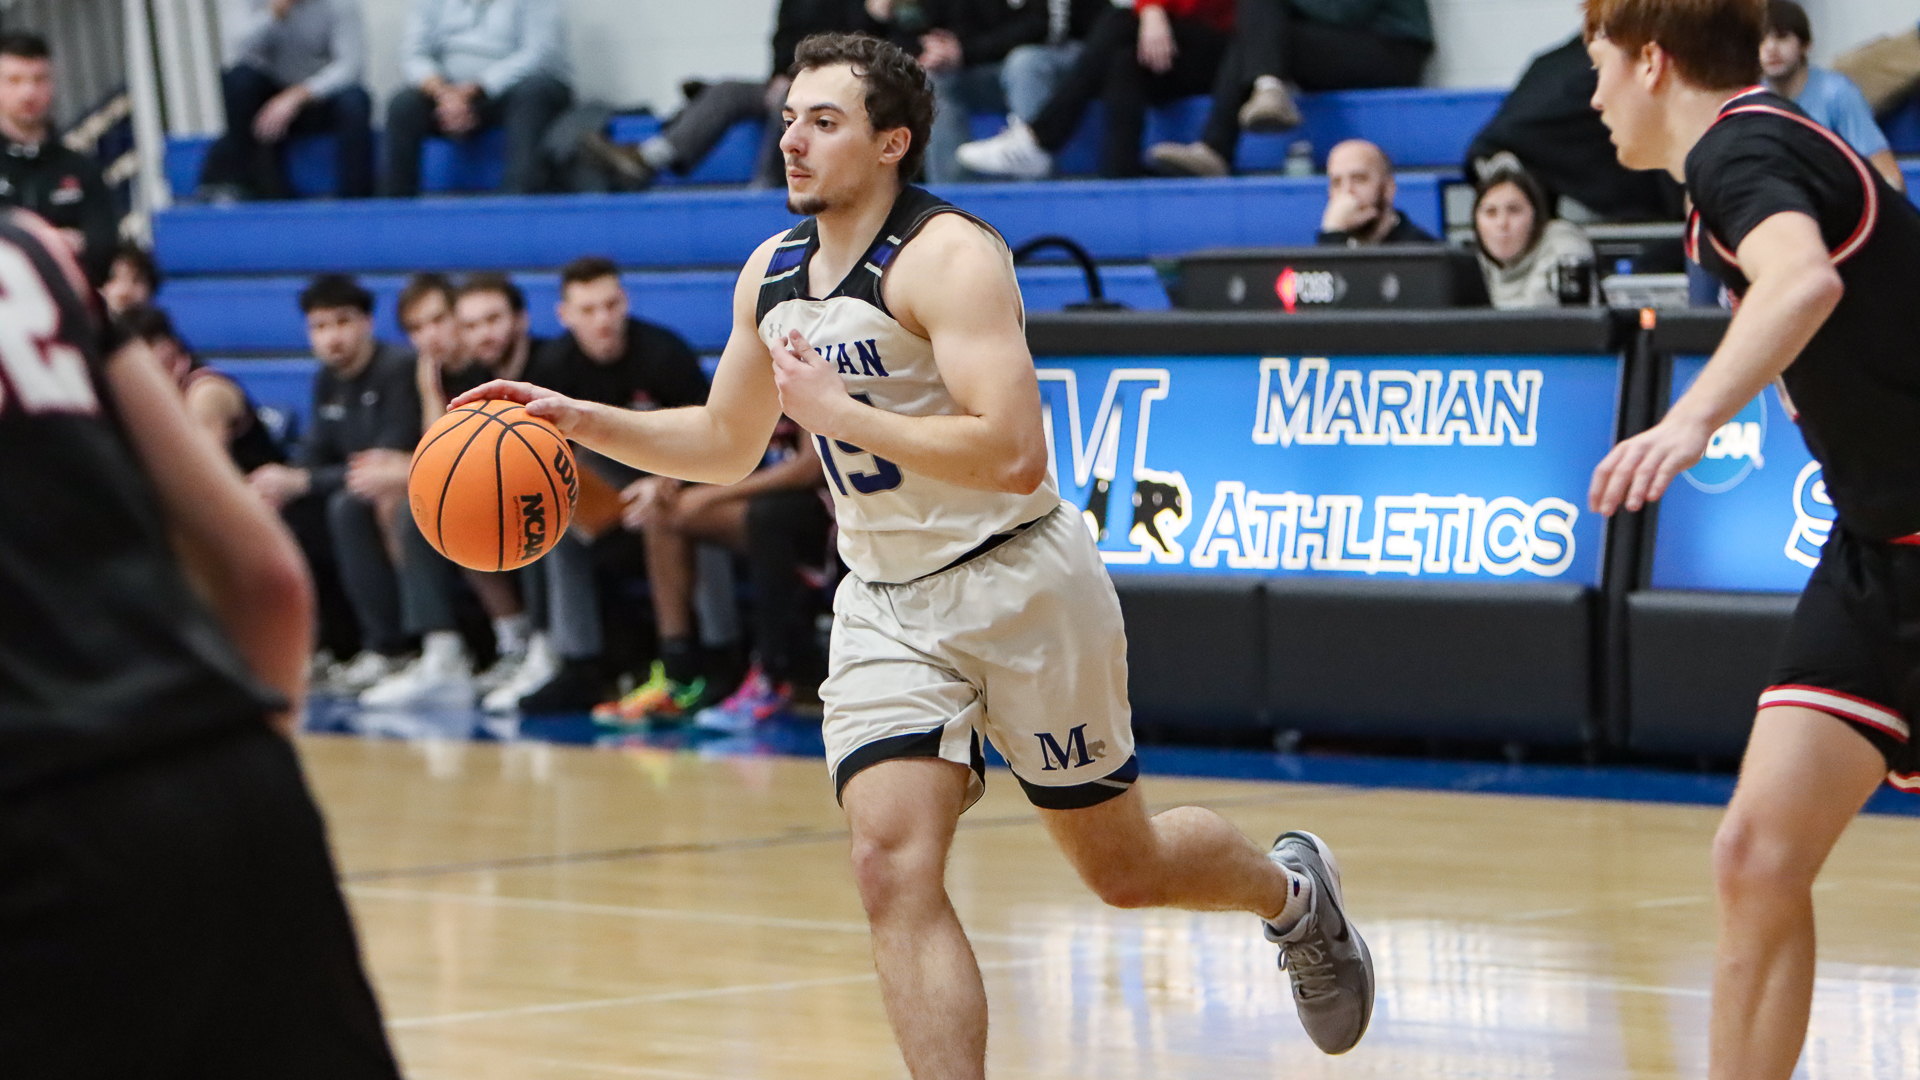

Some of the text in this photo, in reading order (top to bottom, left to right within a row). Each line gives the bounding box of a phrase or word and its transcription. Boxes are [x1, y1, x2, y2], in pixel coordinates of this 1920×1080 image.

[0, 236, 98, 413] 2
[1252, 358, 1543, 446] MARIAN
[520, 493, 546, 561] NCAA
[1190, 481, 1579, 576] ATHLETICS
